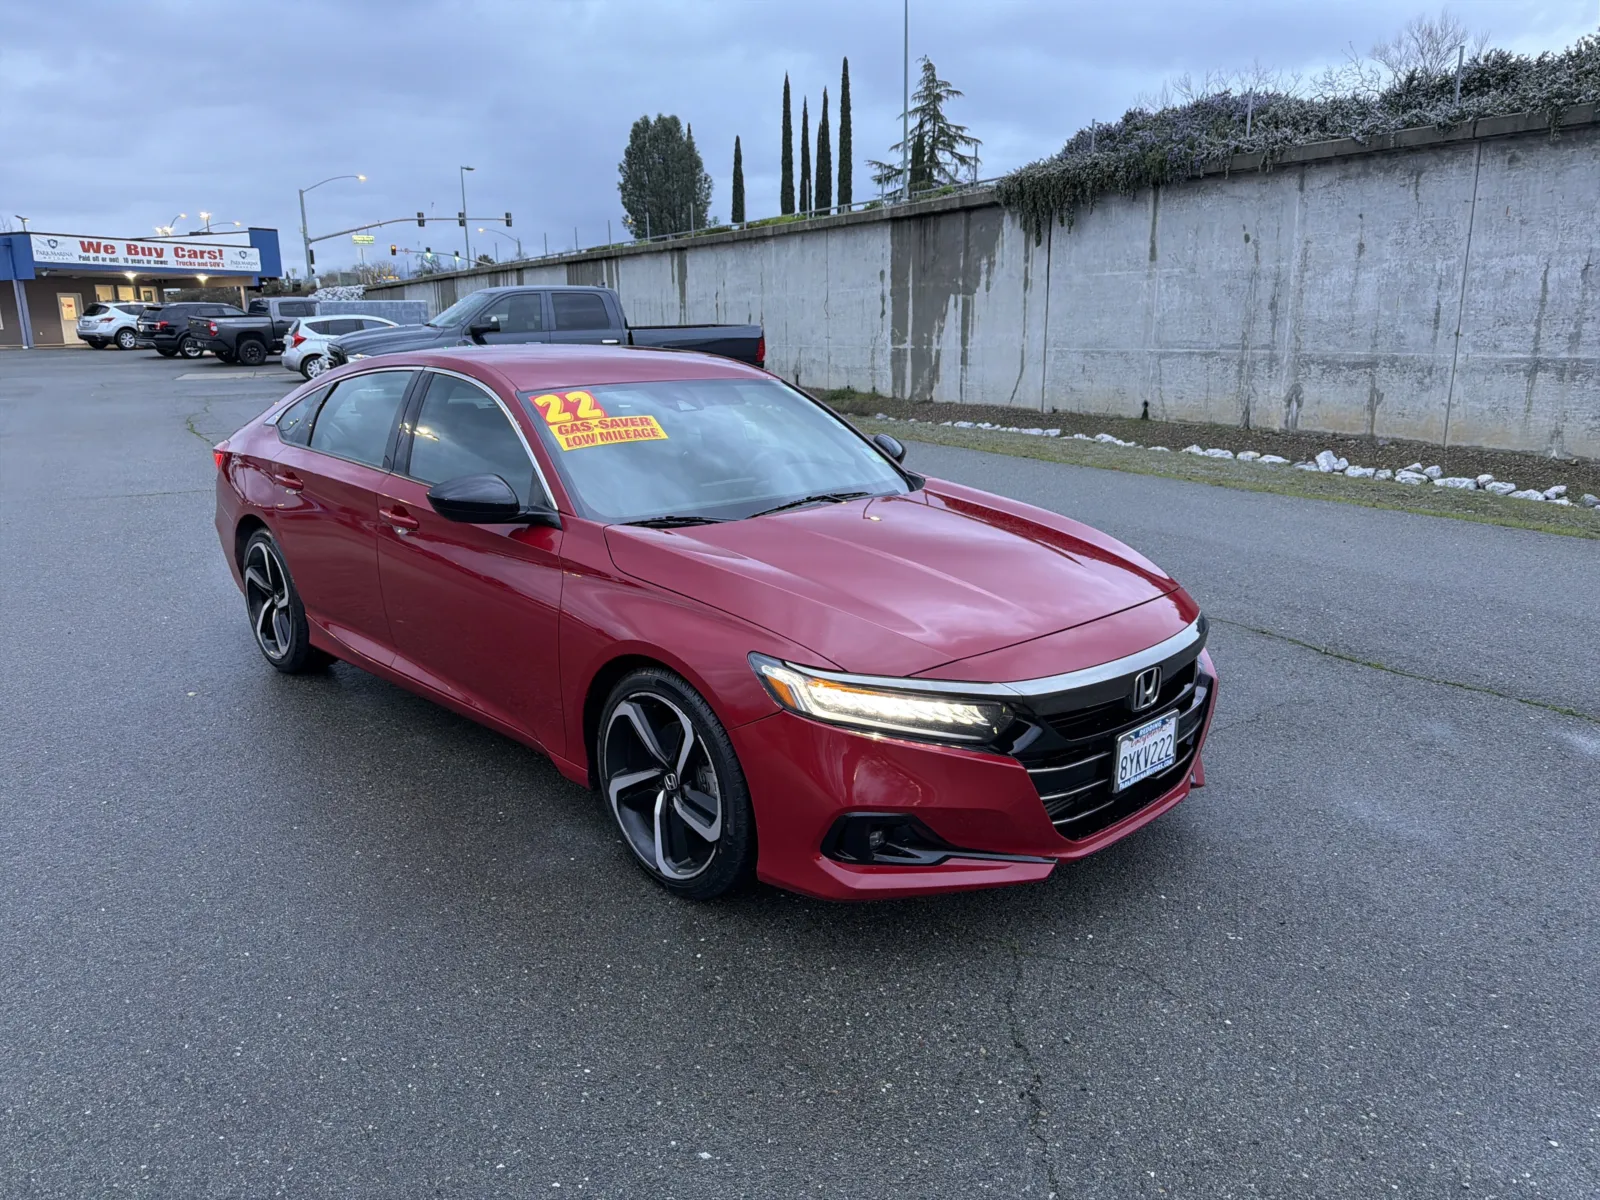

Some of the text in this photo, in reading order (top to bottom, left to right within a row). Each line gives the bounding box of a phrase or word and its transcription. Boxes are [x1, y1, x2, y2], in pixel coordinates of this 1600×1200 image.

[79, 240, 224, 260] We Buy Cars!
[534, 391, 604, 423] 22
[557, 417, 653, 436] GAS-SAVER
[565, 427, 661, 448] LOW MILEAGE
[1120, 734, 1172, 780] 8YKV222
